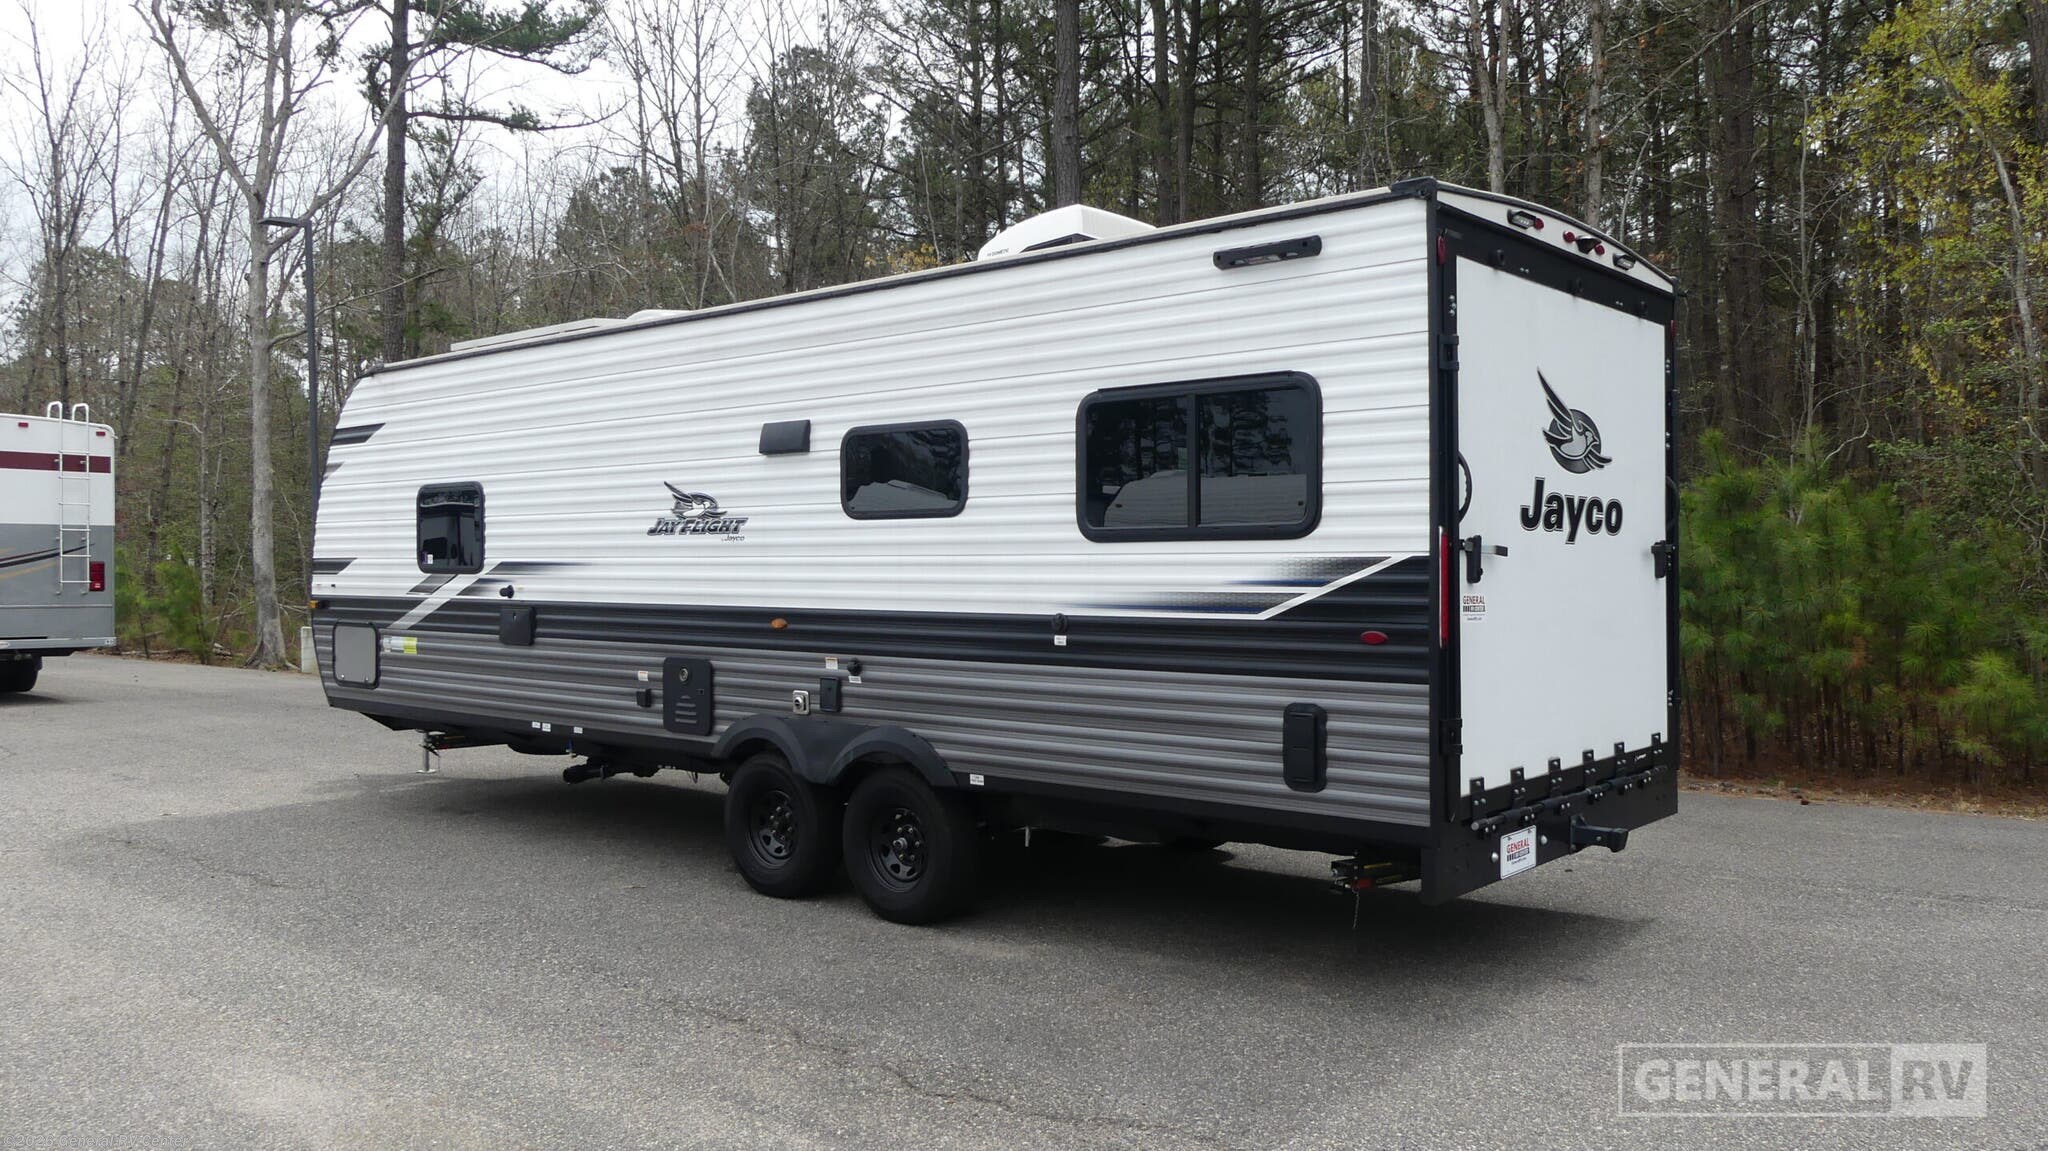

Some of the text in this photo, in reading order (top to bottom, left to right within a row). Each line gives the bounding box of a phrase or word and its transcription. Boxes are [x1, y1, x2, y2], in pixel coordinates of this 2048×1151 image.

[1520, 477, 1623, 545] Jayco
[647, 517, 749, 536] JAY FLIGHT
[1463, 595, 1485, 605] GENERAL
[1506, 837, 1530, 854] GENERAL
